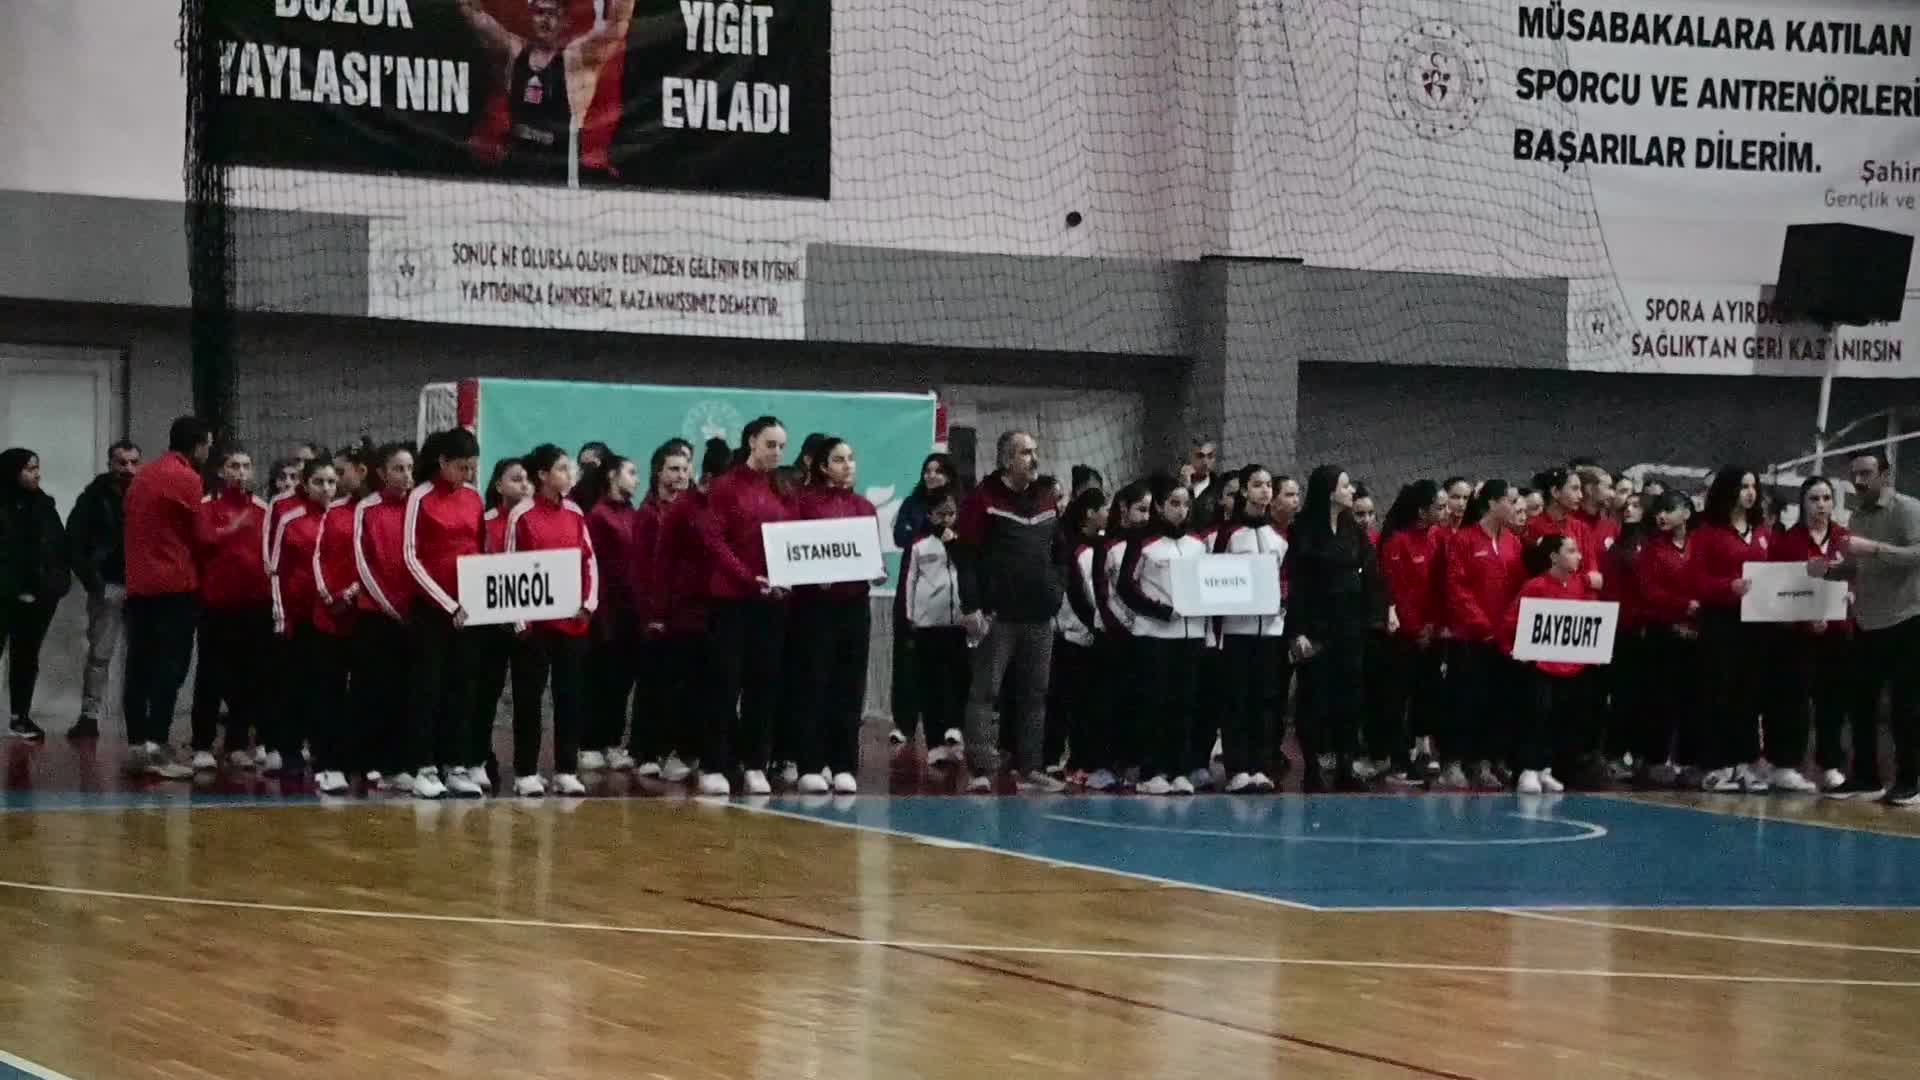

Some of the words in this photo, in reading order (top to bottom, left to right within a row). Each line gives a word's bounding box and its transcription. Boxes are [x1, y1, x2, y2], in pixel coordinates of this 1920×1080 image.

[1518, 0, 1775, 50] MÜSABAKALARA
[1785, 20, 1912, 57] KATILAN
[662, 77, 790, 135] EVLADI
[1516, 67, 1641, 105] SPORCU
[1651, 75, 1689, 107] VE
[1697, 75, 1920, 117] ANTRENÖRLERİ
[1513, 128, 1686, 173] BAŞARILAR
[1695, 129, 1822, 173] DİLERİM.
[1896, 194, 1916, 210] ve
[452, 242, 497, 271] SONUÇ
[1646, 297, 1704, 324] SPORA
[1631, 326, 1738, 359] SAĞLIKTAN
[1743, 332, 1783, 360] GERİ
[1531, 613, 1603, 649] BAYBURT
